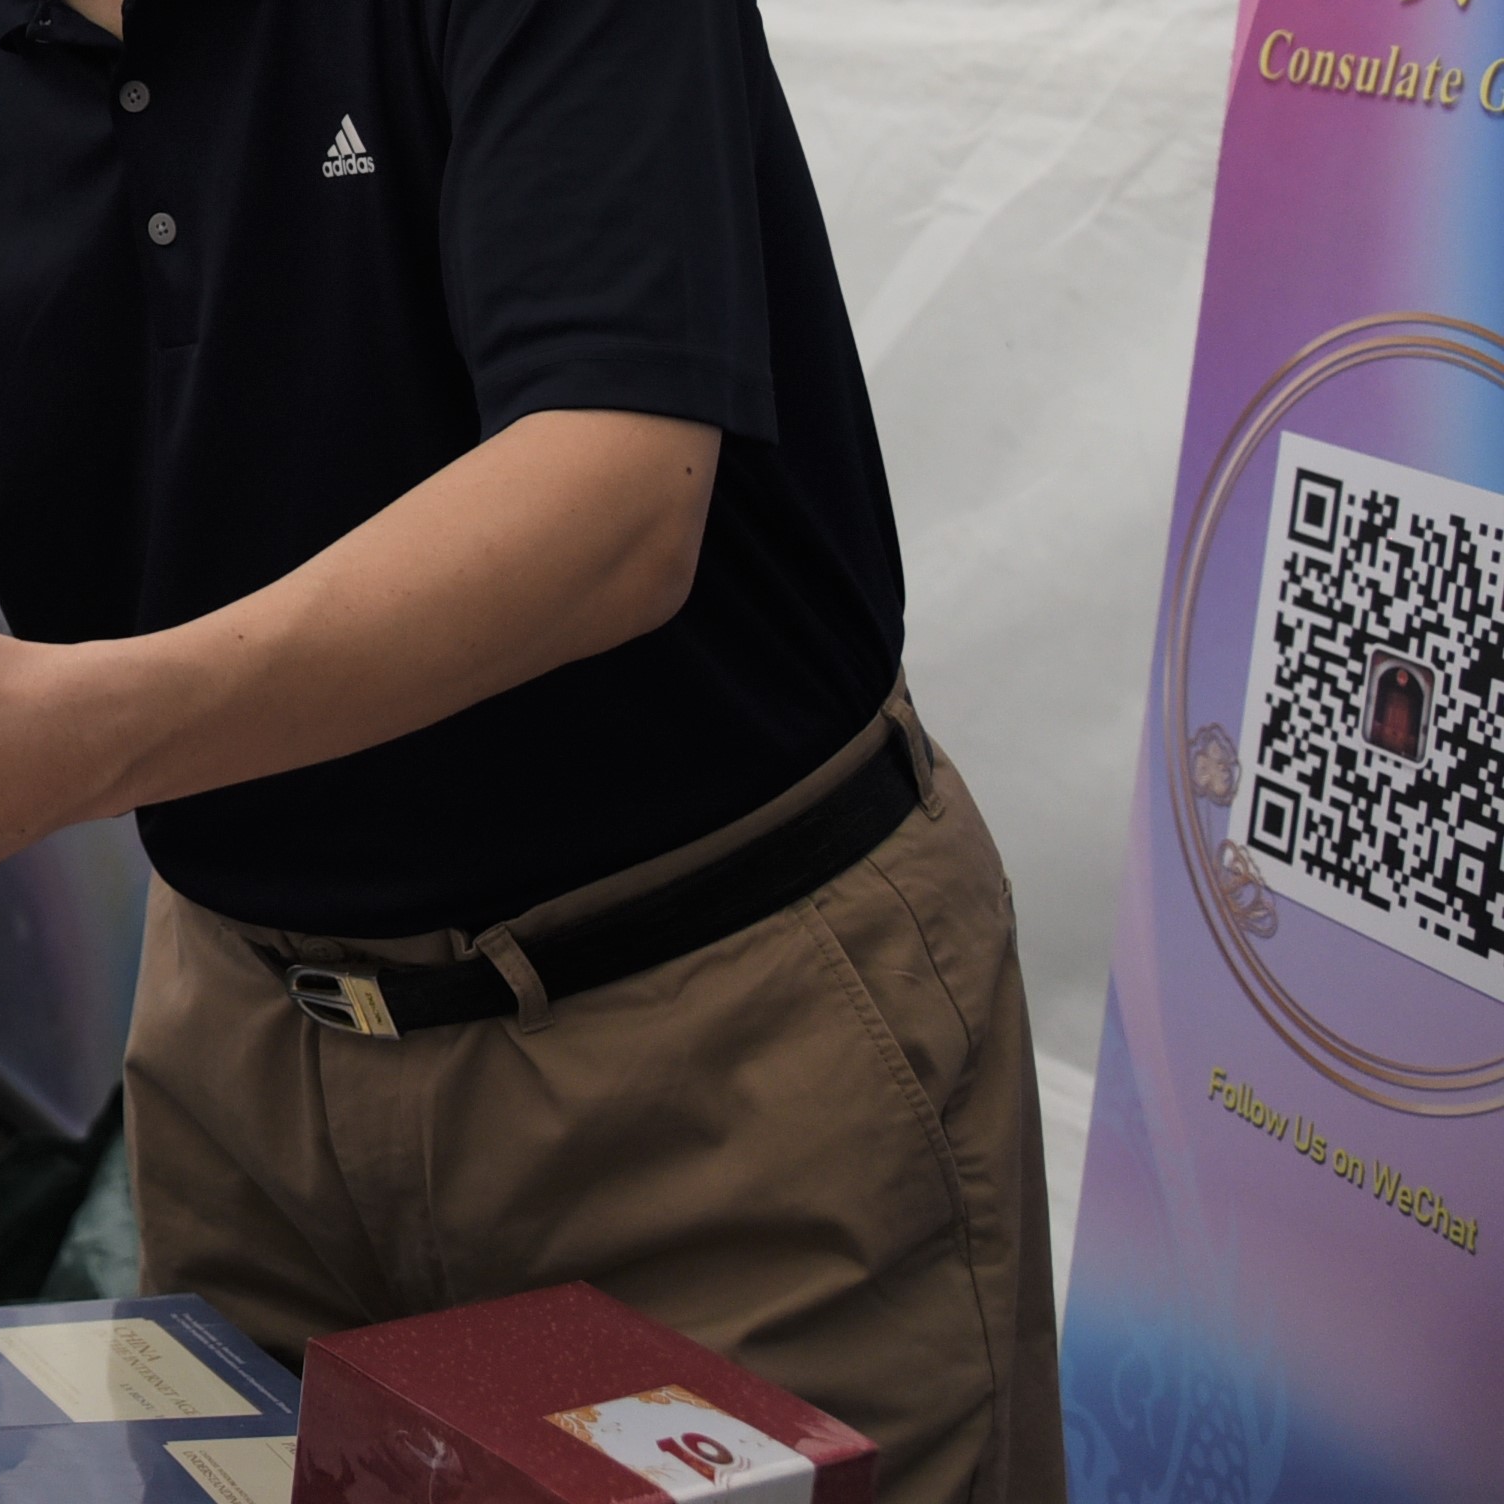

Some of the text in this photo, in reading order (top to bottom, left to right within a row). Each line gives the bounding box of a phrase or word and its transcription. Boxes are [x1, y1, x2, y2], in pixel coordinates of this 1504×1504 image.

[1259, 29, 1464, 106] Consulate
[322, 153, 375, 178] adidas
[1208, 1067, 1479, 1253] Follow Us on WeChat
[114, 1327, 162, 1362] CHINA
